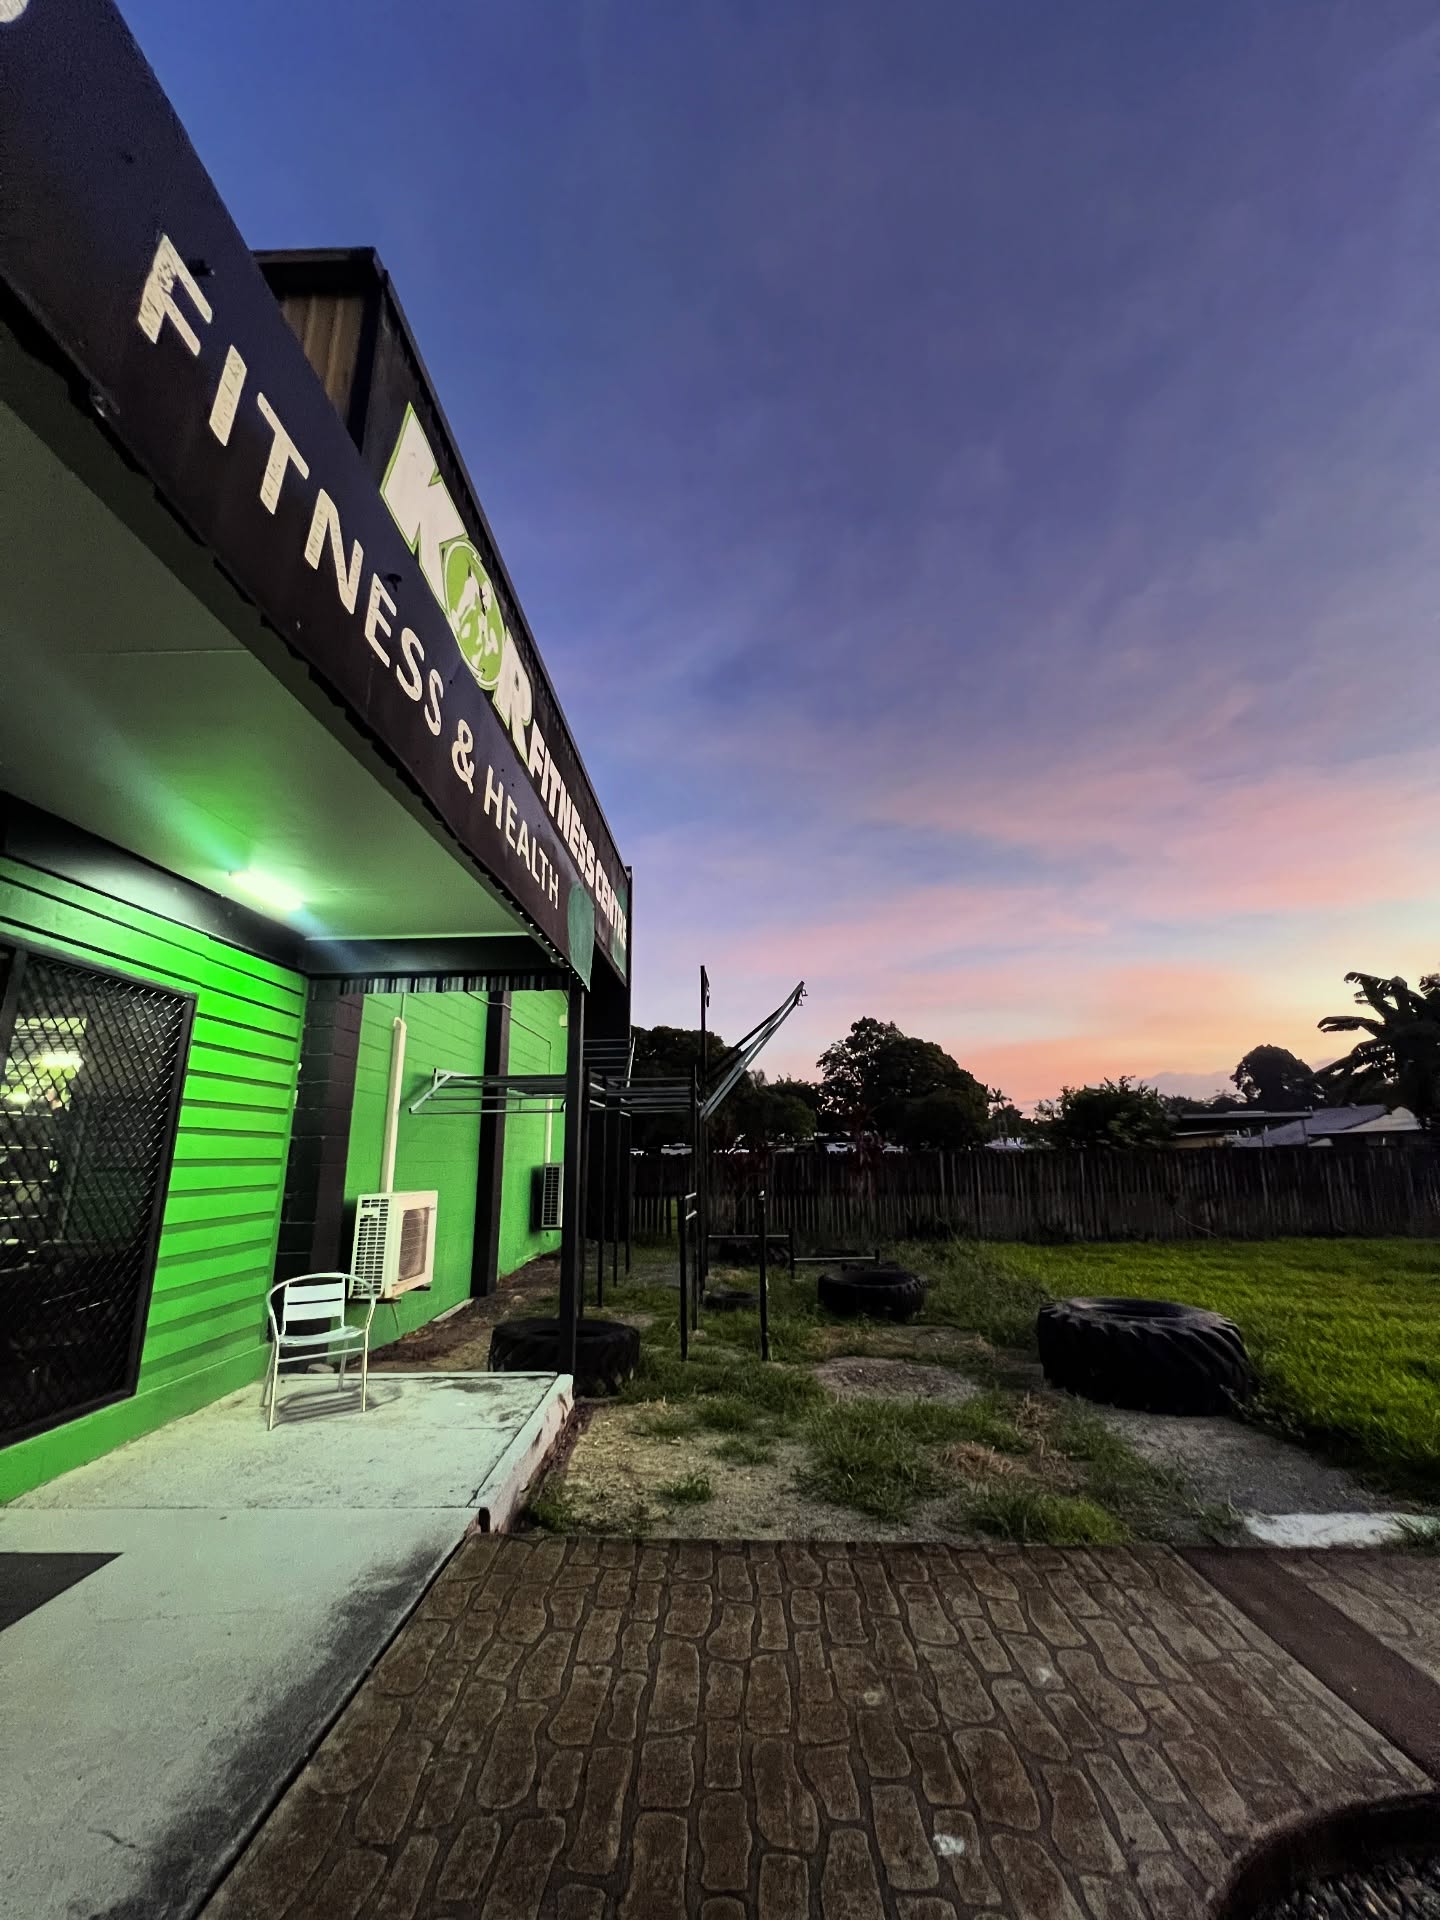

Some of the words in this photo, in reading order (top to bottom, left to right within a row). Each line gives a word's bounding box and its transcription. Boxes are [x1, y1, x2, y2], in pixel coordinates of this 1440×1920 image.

[137, 233, 443, 736] FITNESS
[451, 718, 475, 794] &
[484, 765, 559, 910] HEALTH
[528, 718, 595, 889] FITNESS
